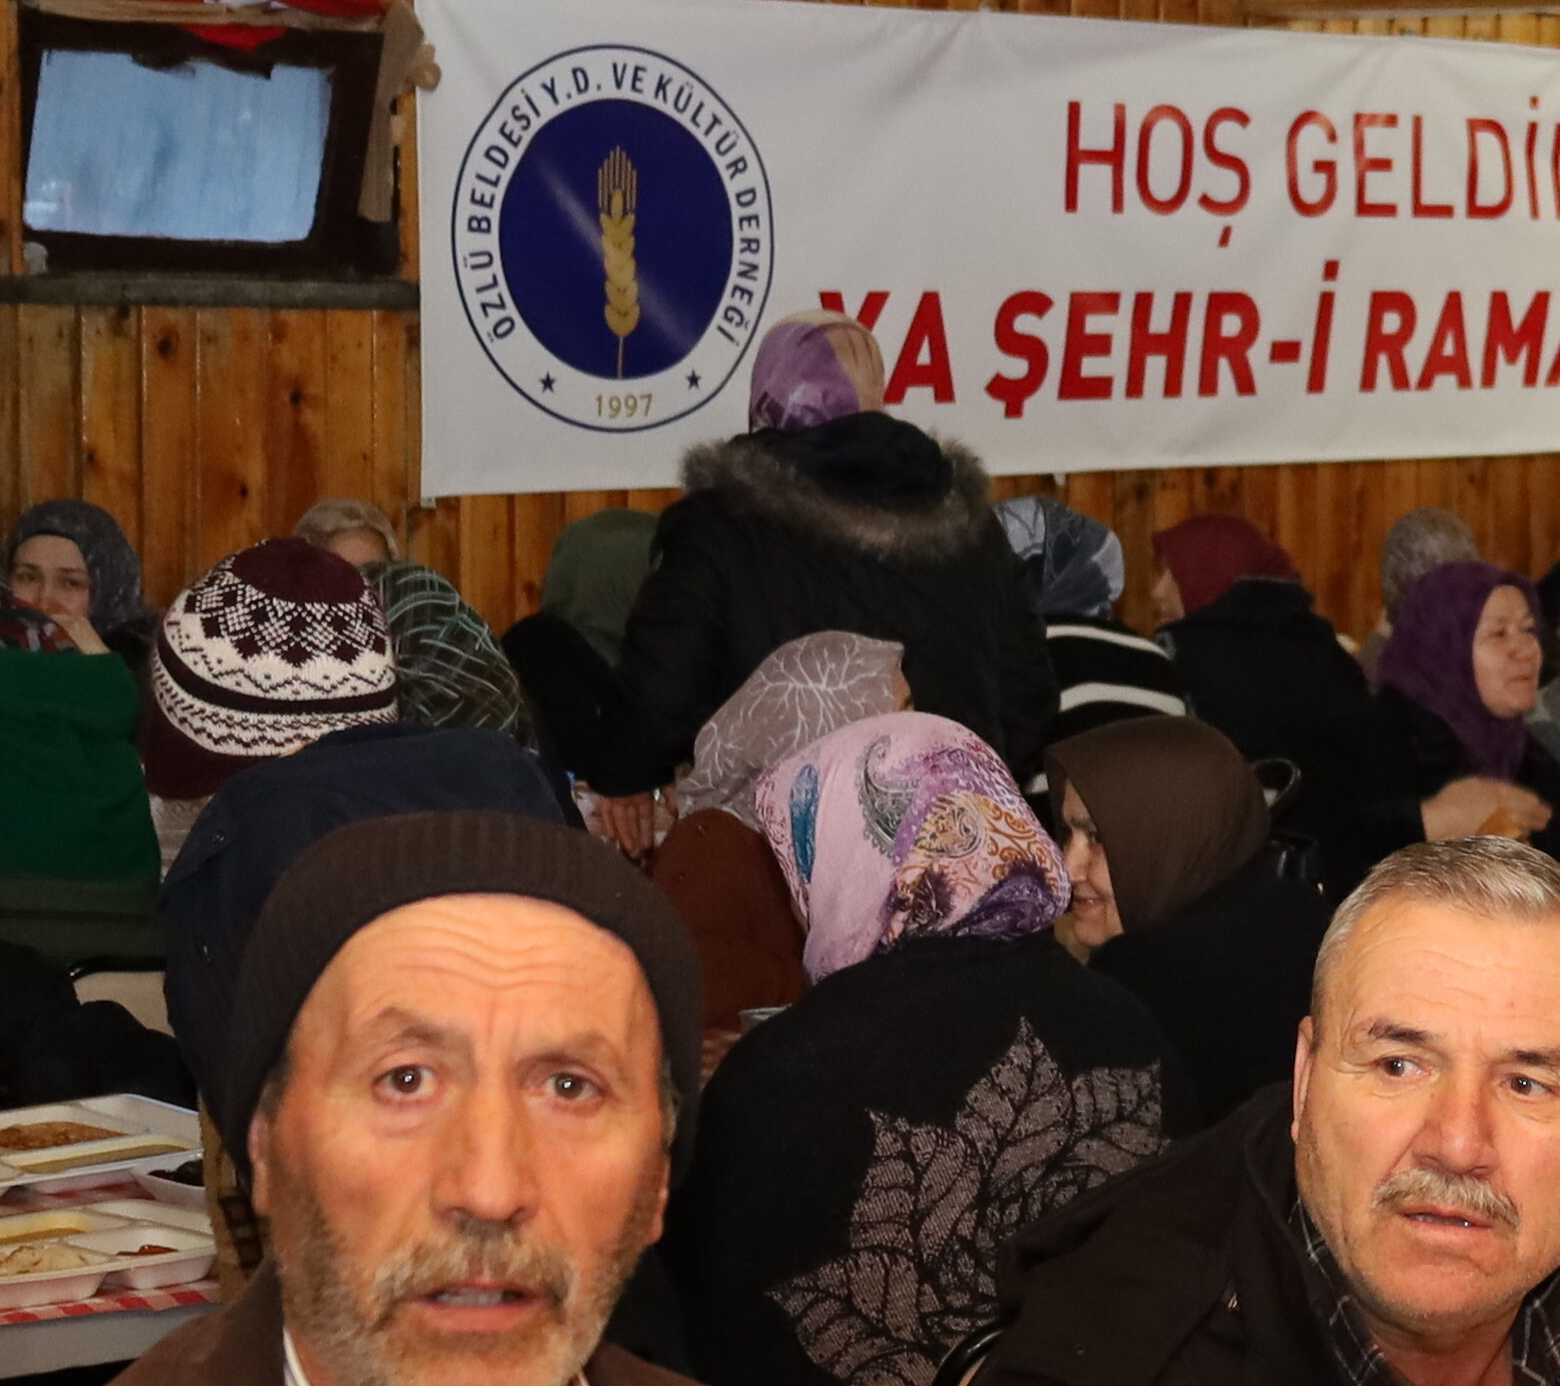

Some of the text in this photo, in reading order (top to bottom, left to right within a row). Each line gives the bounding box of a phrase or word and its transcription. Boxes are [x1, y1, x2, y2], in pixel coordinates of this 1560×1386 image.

[464, 61, 761, 348] ÖZLÜ BELDESİ Y.D. VE KÜLTÜR DERNEĞİ
[1064, 100, 1251, 247] HOŞ
[595, 393, 654, 418] 1997
[984, 259, 1340, 419] ŞEHR-İ
